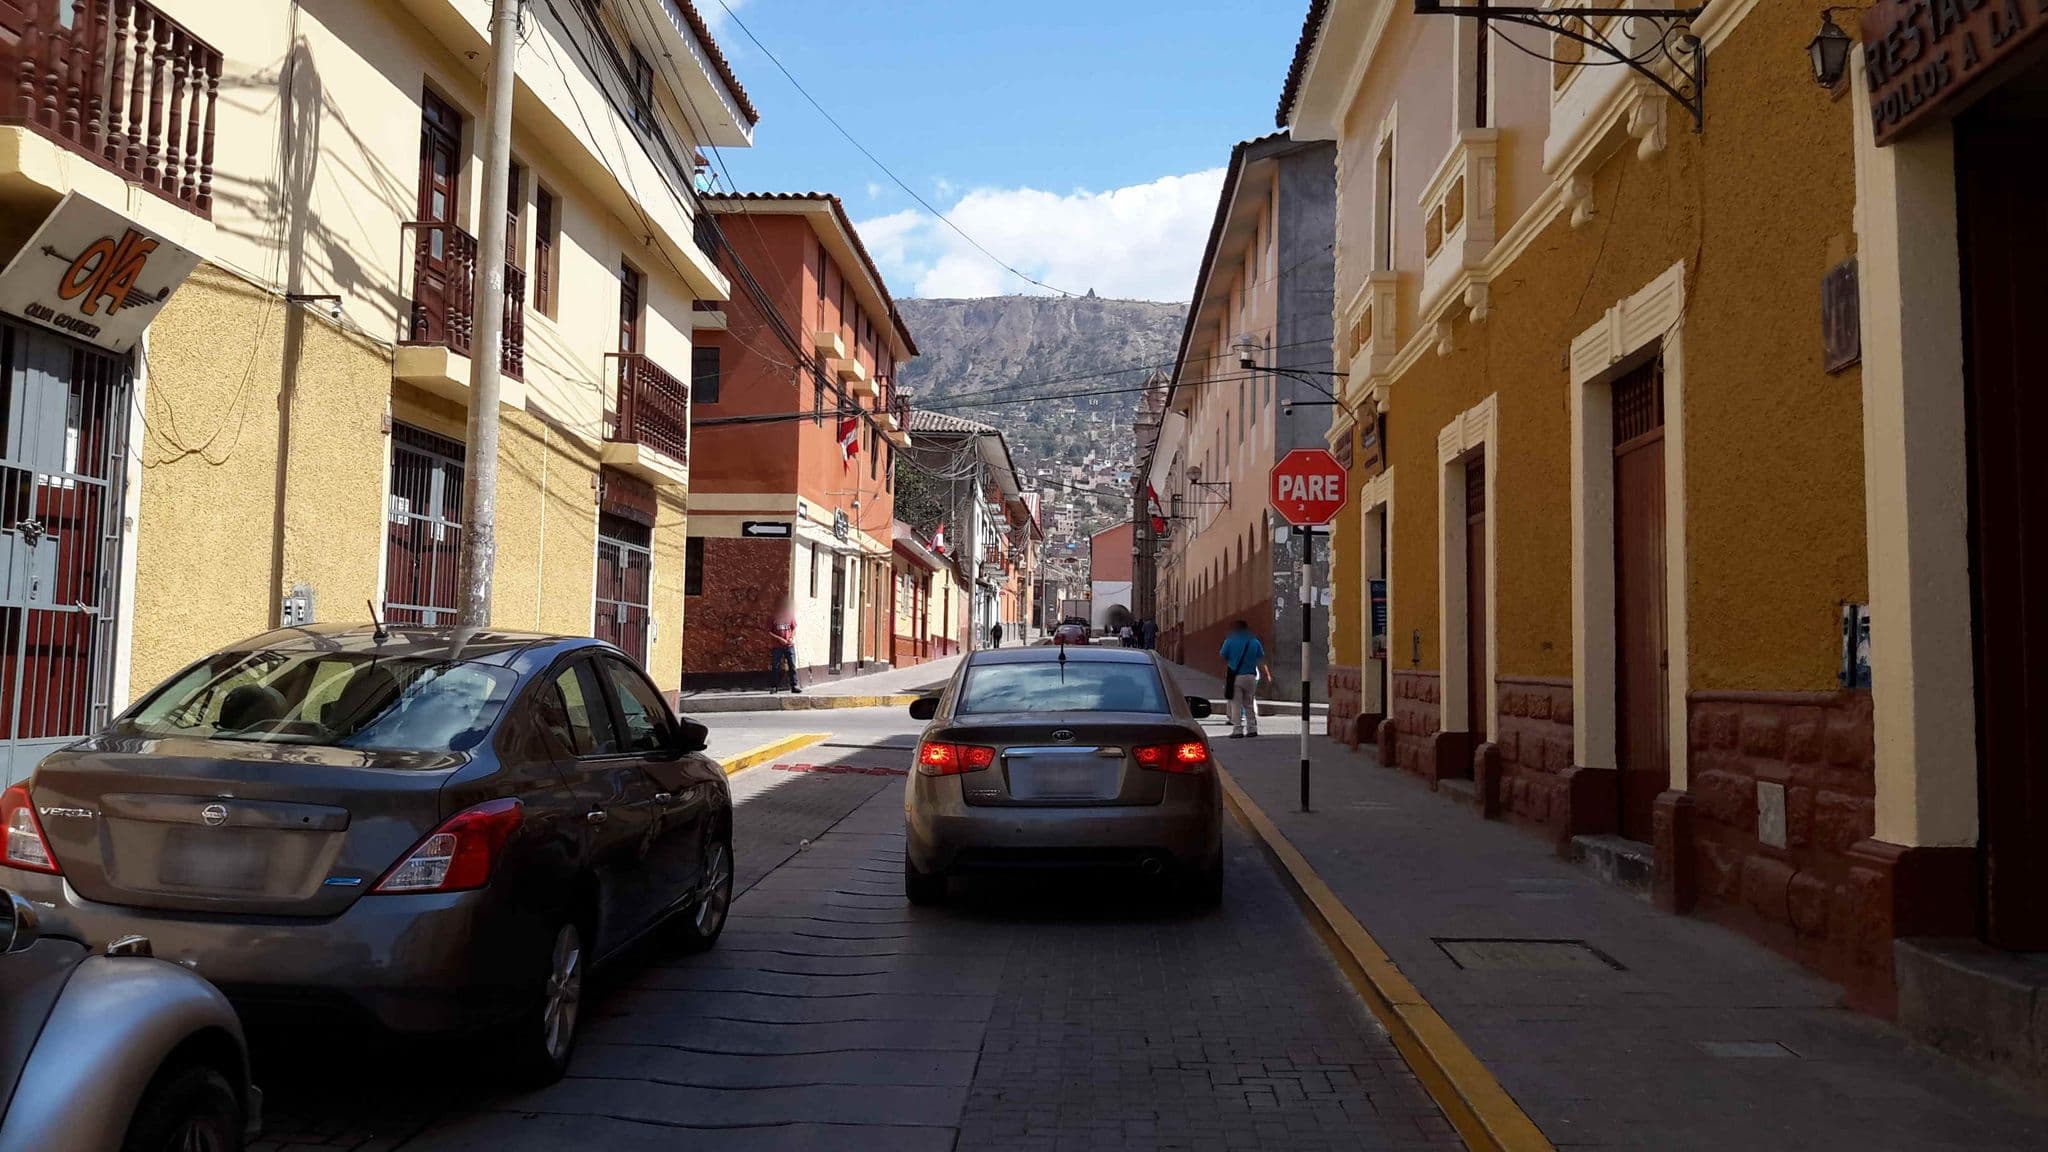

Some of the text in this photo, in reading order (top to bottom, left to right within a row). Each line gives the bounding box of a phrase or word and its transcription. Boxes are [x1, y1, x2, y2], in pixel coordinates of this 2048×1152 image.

[1873, 0, 2021, 136] POLLOS A LA
[1278, 474, 1340, 501] PARE
